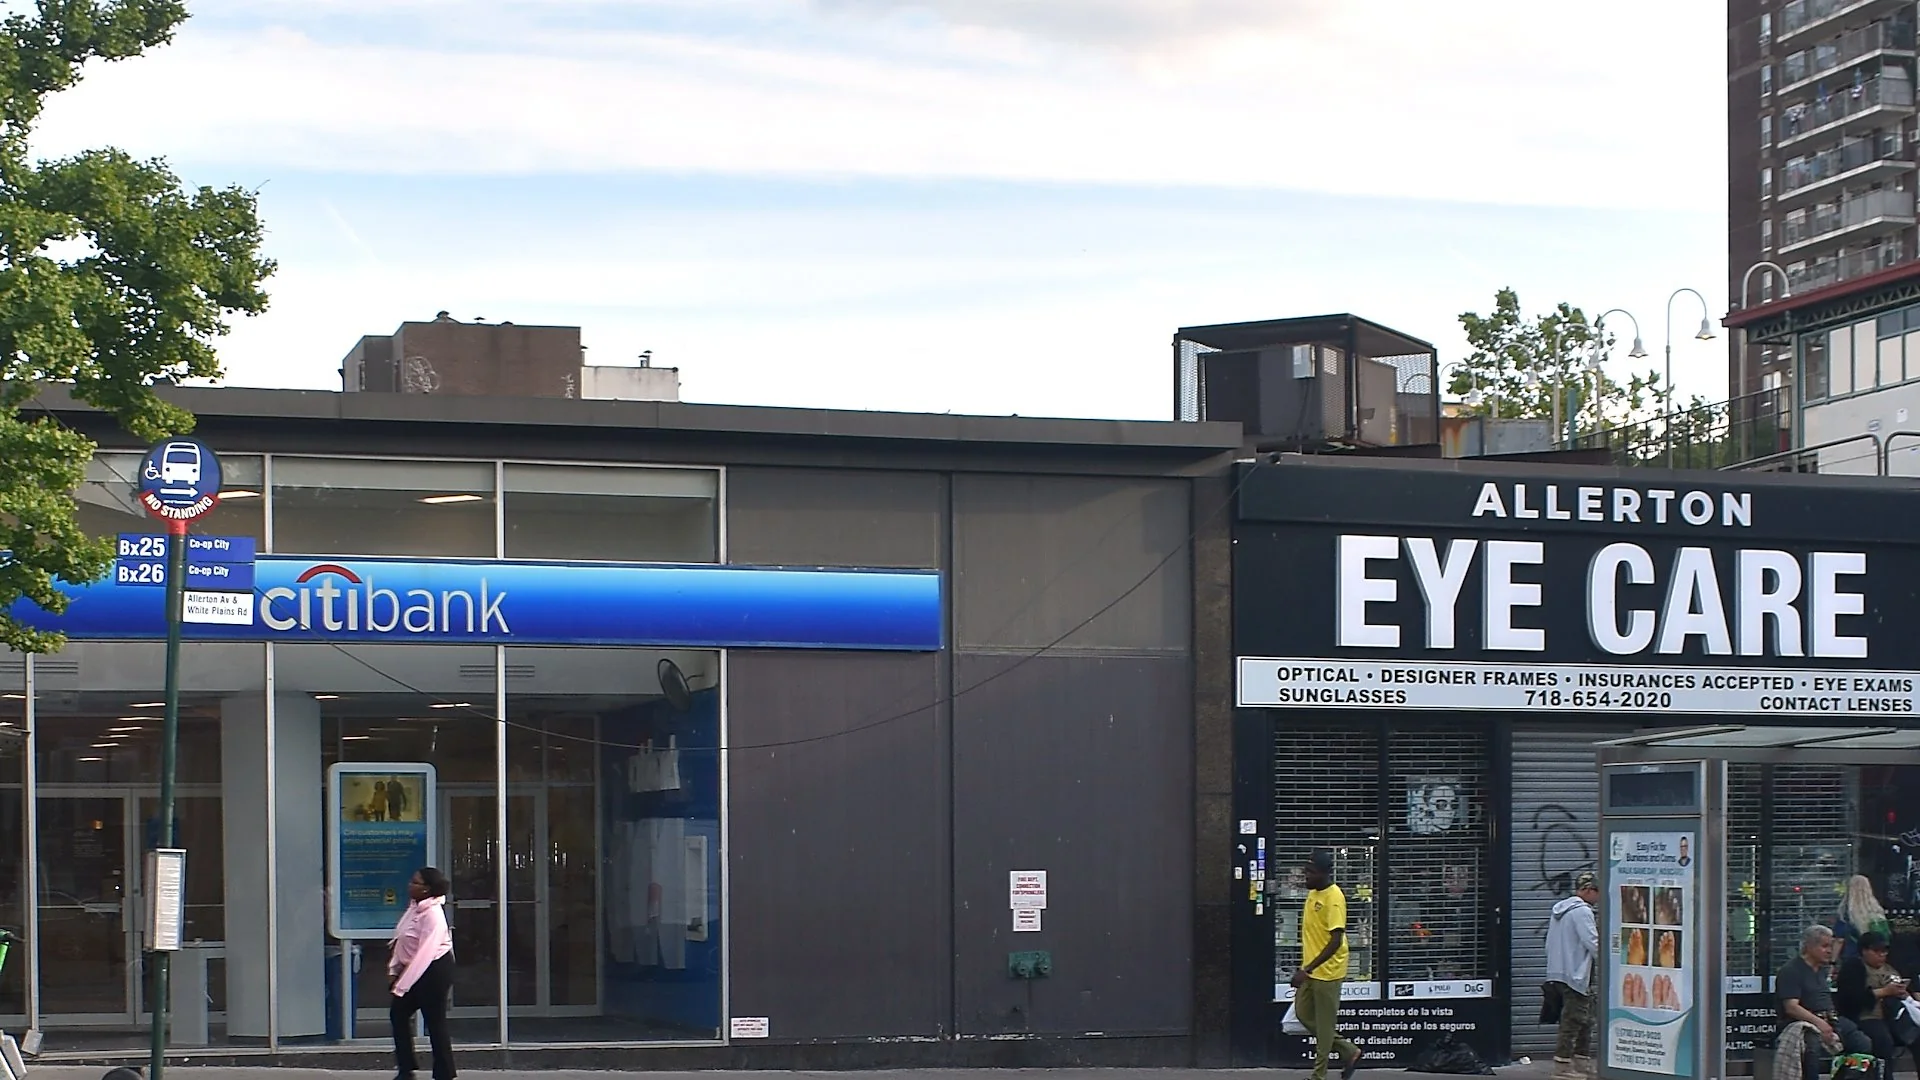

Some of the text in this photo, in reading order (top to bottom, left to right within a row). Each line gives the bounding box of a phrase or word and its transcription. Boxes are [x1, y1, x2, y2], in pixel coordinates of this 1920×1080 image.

[144, 493, 214, 519] NO STANDING
[1472, 482, 1751, 526] ALLERTON
[119, 537, 165, 557] Bx25
[189, 538, 230, 551] Co-op City
[118, 563, 164, 583] Bx26
[188, 565, 229, 578] Co-op City
[187, 594, 238, 604] Allerton Av &
[259, 573, 511, 632] citibank
[1335, 534, 1868, 658] EYE CARE
[187, 605, 248, 616] White Plains Rd
[1277, 667, 1913, 693] OPTICAL DESIGNER FRAMES INSURANCES ACCEPTED EYE EXAMS
[1279, 688, 1407, 704] SUNGLASSES
[1525, 690, 1671, 708] 718-654-2020
[1760, 697, 1913, 712] CONTACT LENSES
[1636, 842, 1650, 853] Easy
[1649, 854, 1661, 862] and
[1339, 986, 1370, 996] GUCCI
[1464, 983, 1484, 993] D&G
[1358, 1007, 1406, 1018] completos
[1407, 1007, 1419, 1016] de
[1421, 1007, 1429, 1016] la
[1431, 1007, 1454, 1016] vista
[1361, 1022, 1370, 1031] la
[1410, 1021, 1421, 1031] de
[1424, 1021, 1437, 1031] los
[1439, 1022, 1476, 1033] seguros
[1353, 1036, 1366, 1045] de
[1367, 1035, 1413, 1045] diseñador
[1361, 1050, 1396, 1059] ontacto
